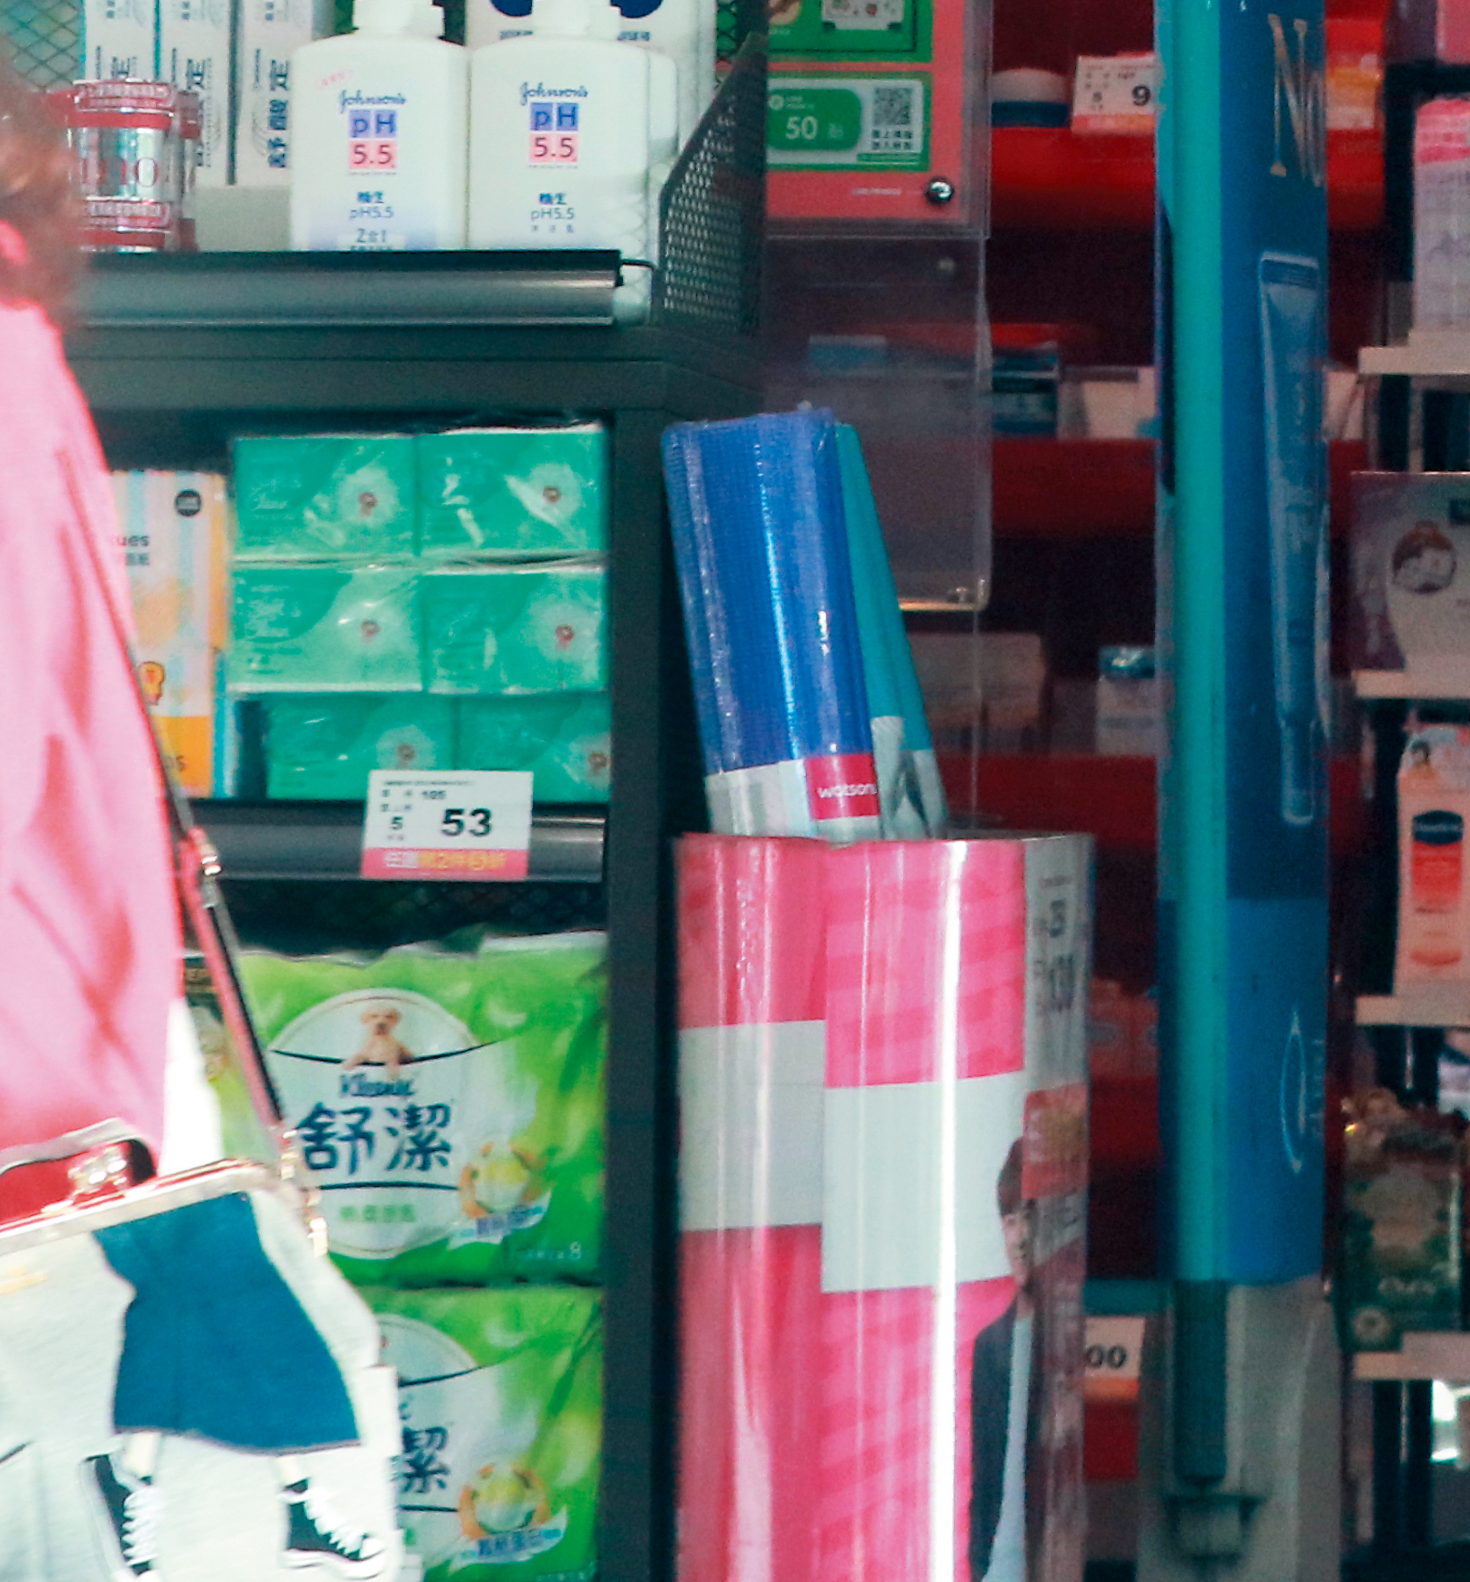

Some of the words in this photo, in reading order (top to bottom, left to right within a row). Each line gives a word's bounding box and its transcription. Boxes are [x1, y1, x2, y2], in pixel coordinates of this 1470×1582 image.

[352, 112, 396, 138] pH
[533, 104, 578, 131] pH
[785, 115, 819, 142] 50
[352, 144, 394, 166] 5.5
[533, 136, 575, 159] 5.5
[530, 207, 575, 221] pH5.5
[440, 807, 493, 837] 53
[295, 1102, 453, 1176] 舒潔
